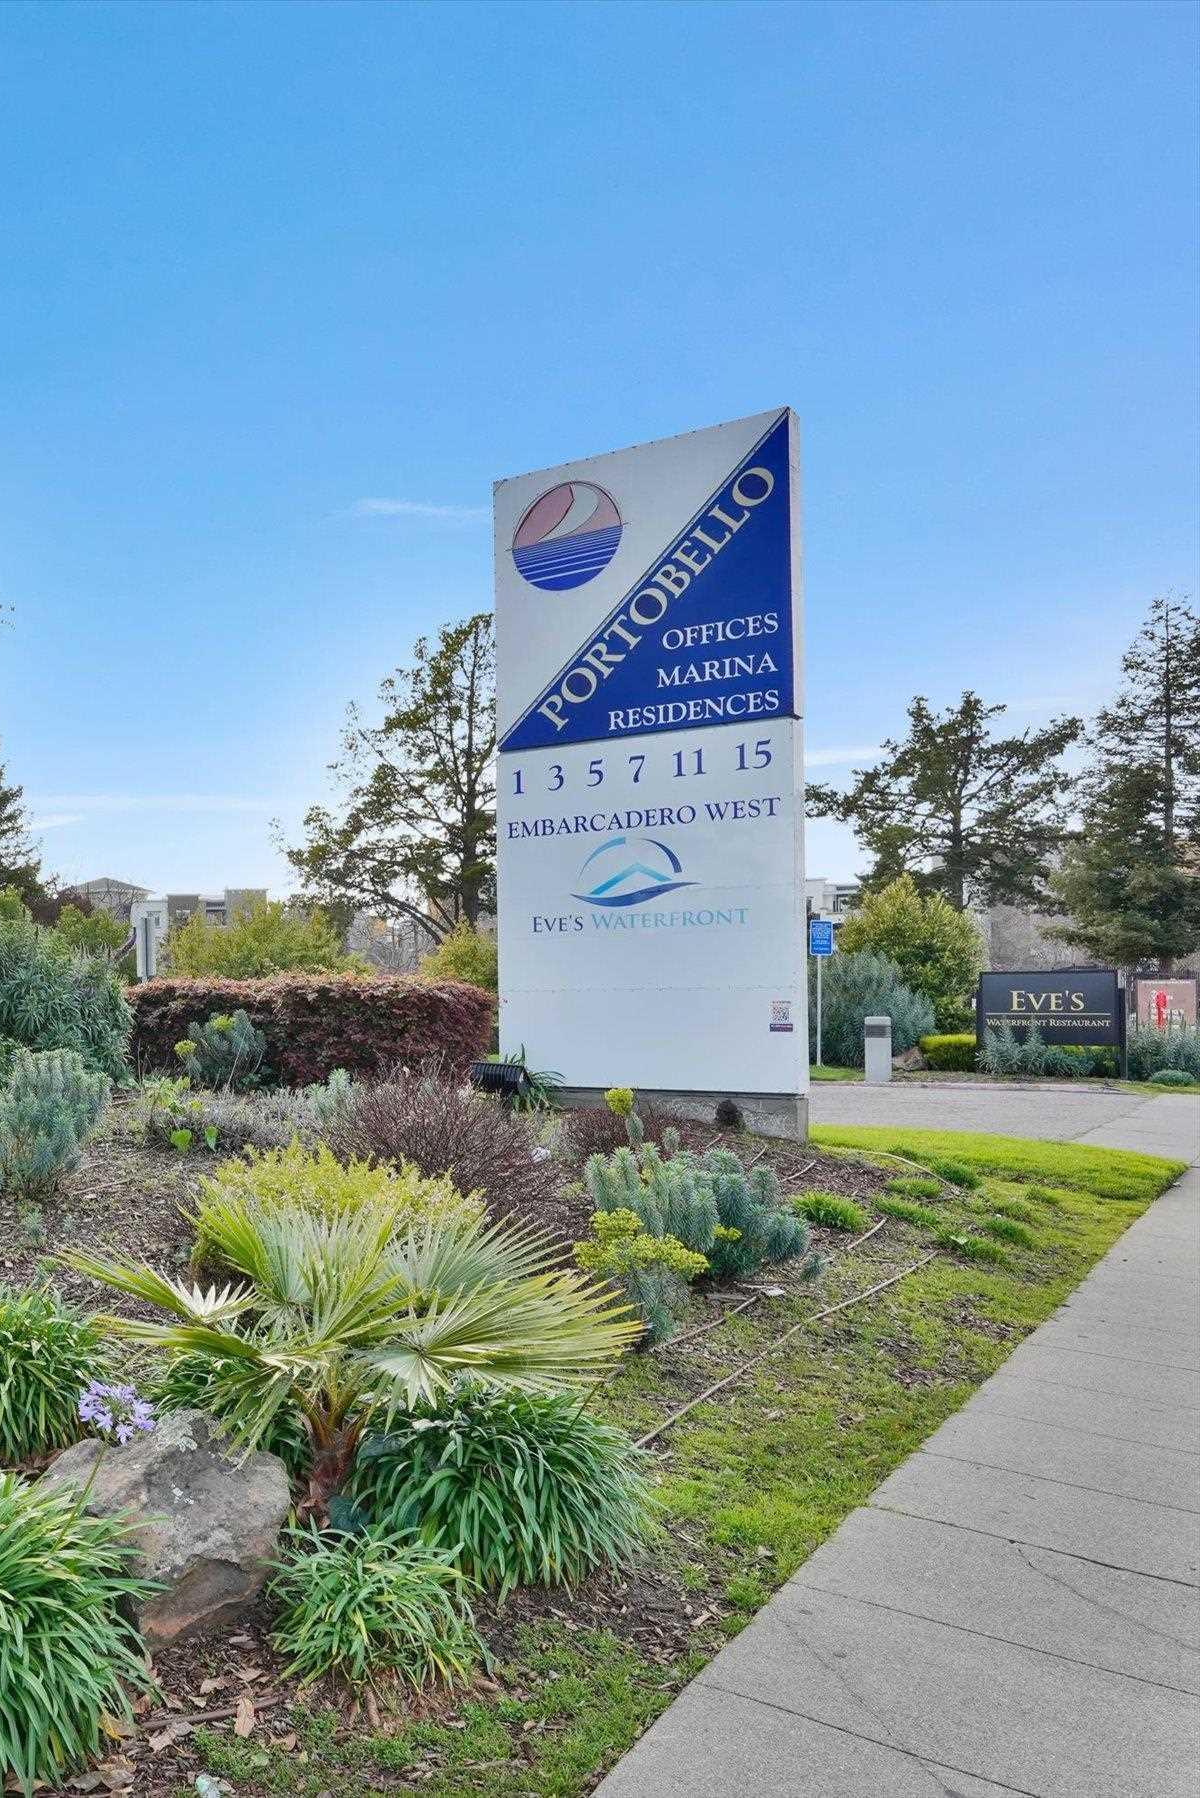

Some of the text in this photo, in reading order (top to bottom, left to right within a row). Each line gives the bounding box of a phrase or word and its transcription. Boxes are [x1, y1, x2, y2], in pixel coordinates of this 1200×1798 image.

[537, 466, 776, 732] PORTOBELLO
[662, 613, 779, 650] OFFICES
[656, 652, 779, 689] MARINA
[608, 689, 780, 731] RESIDENCES
[512, 738, 773, 795] 1 3 5 7 11 15
[507, 796, 782, 840] EMBARCADERO WEST
[591, 907, 750, 930] WATERFRONT
